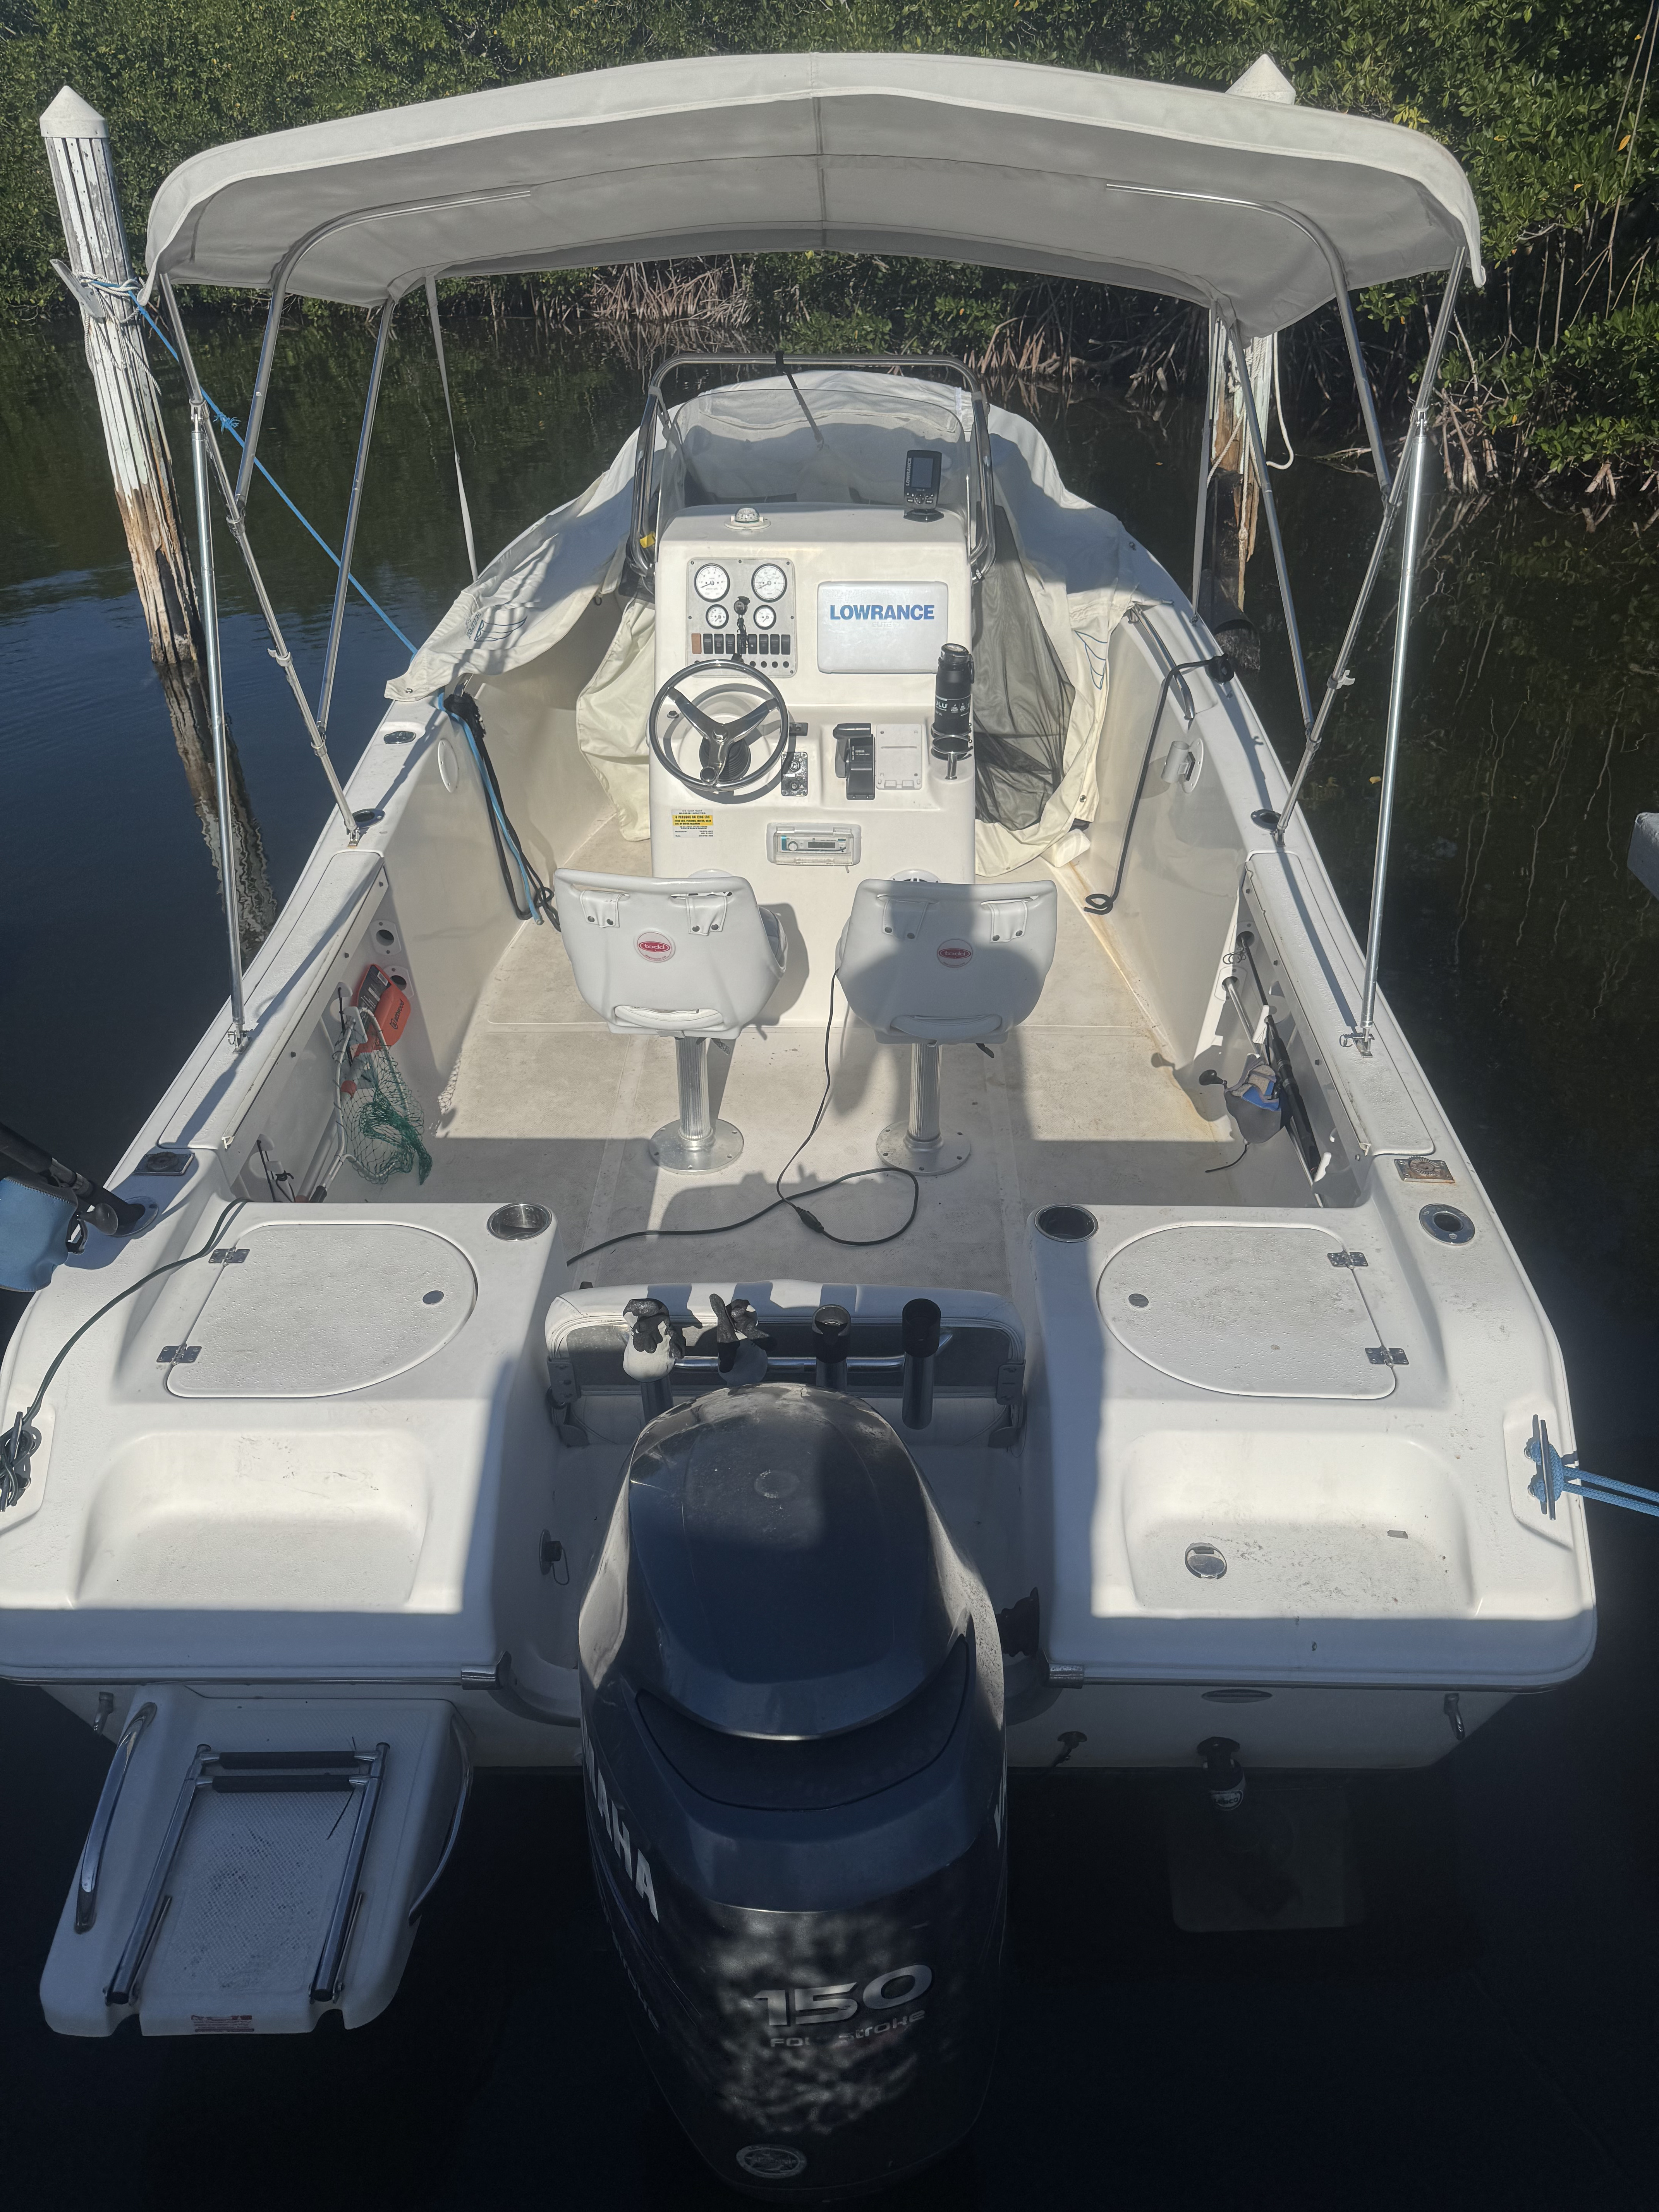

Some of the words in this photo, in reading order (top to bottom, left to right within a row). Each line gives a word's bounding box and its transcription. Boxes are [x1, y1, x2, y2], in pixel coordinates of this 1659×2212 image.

[830, 605, 935, 620] LOWRANCE
[582, 1709, 659, 1923] MAHA
[753, 1964, 933, 2026] 150
